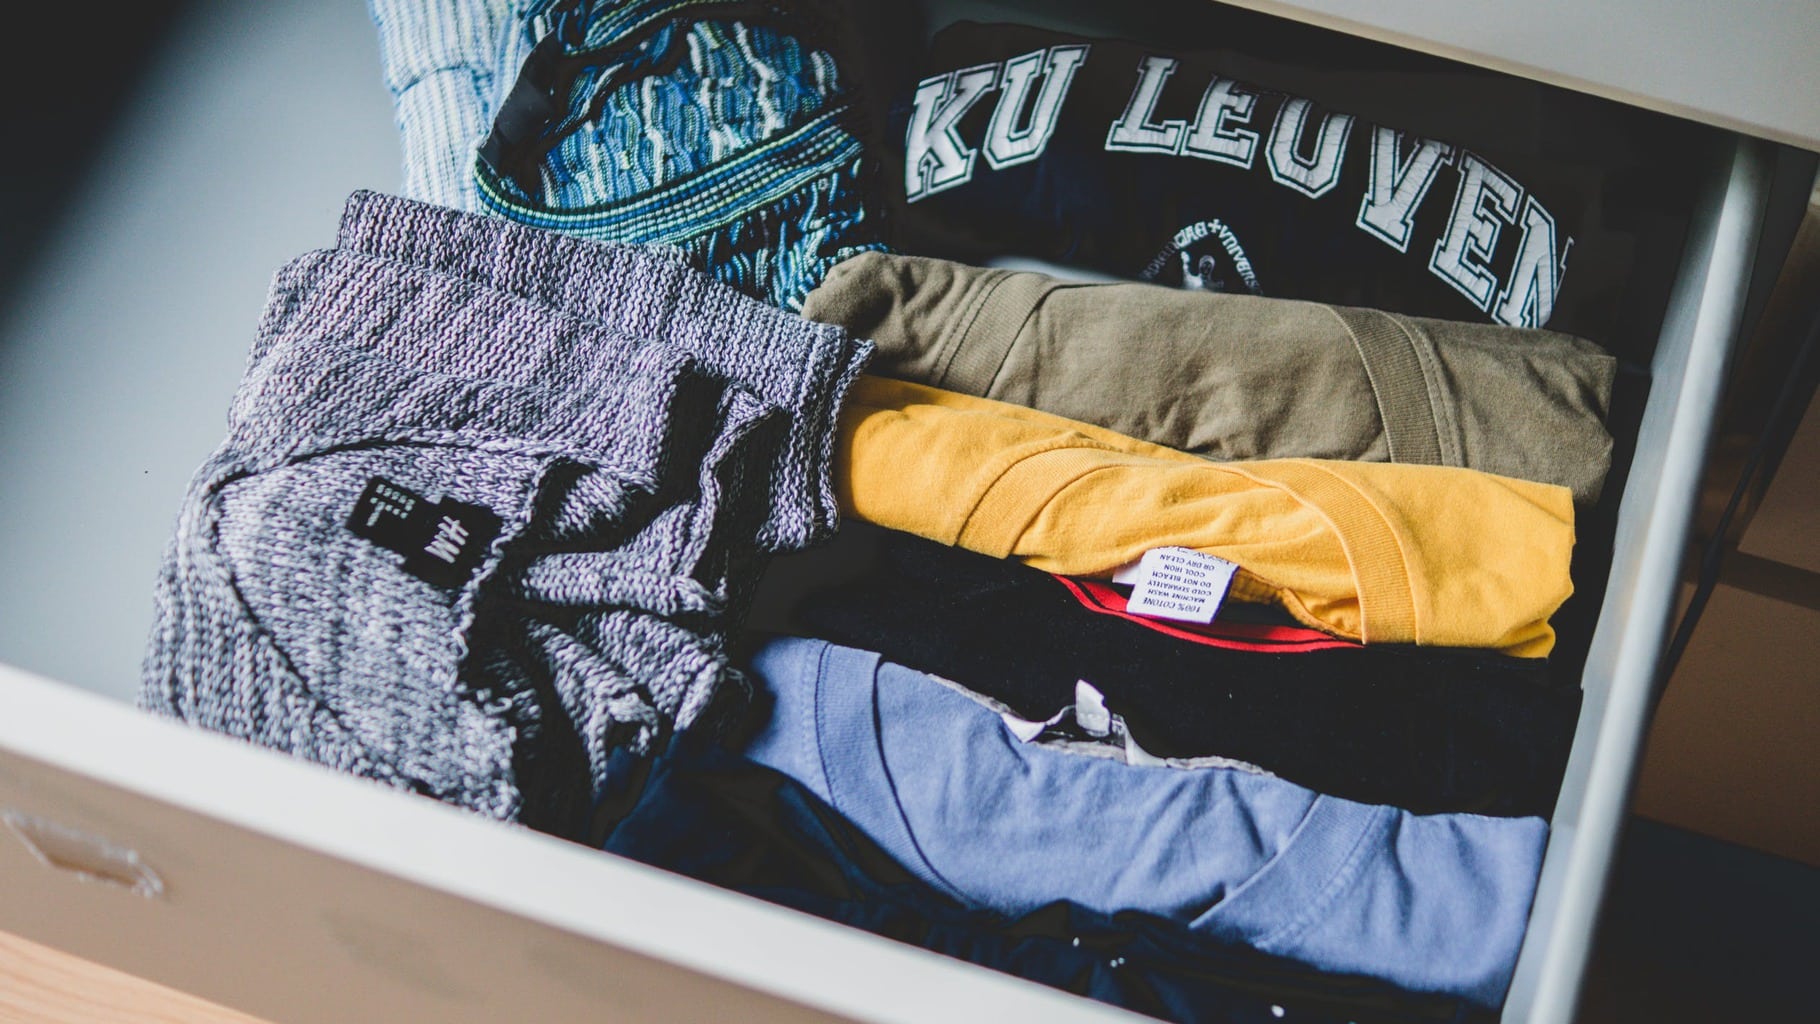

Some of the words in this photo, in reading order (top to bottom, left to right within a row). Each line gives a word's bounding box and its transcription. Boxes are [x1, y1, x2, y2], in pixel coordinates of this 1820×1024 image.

[905, 44, 1091, 203] KU
[1104, 55, 1575, 329] LEUVEN
[1159, 554, 1185, 564] CLEAN
[1164, 564, 1182, 573] IRON
[1186, 559, 1203, 570] DRY
[1204, 563, 1215, 571] OR
[1152, 570, 1181, 582] BLEACH
[1185, 569, 1206, 577] COOL
[1182, 577, 1198, 586] NOT
[1200, 580, 1211, 588] DO
[1147, 580, 1190, 594] SEPARATELY
[1147, 589, 1169, 597] WASH
[1191, 588, 1212, 596] COLD
[1171, 592, 1205, 603] MACHINE
[1178, 603, 1201, 613] 100%
